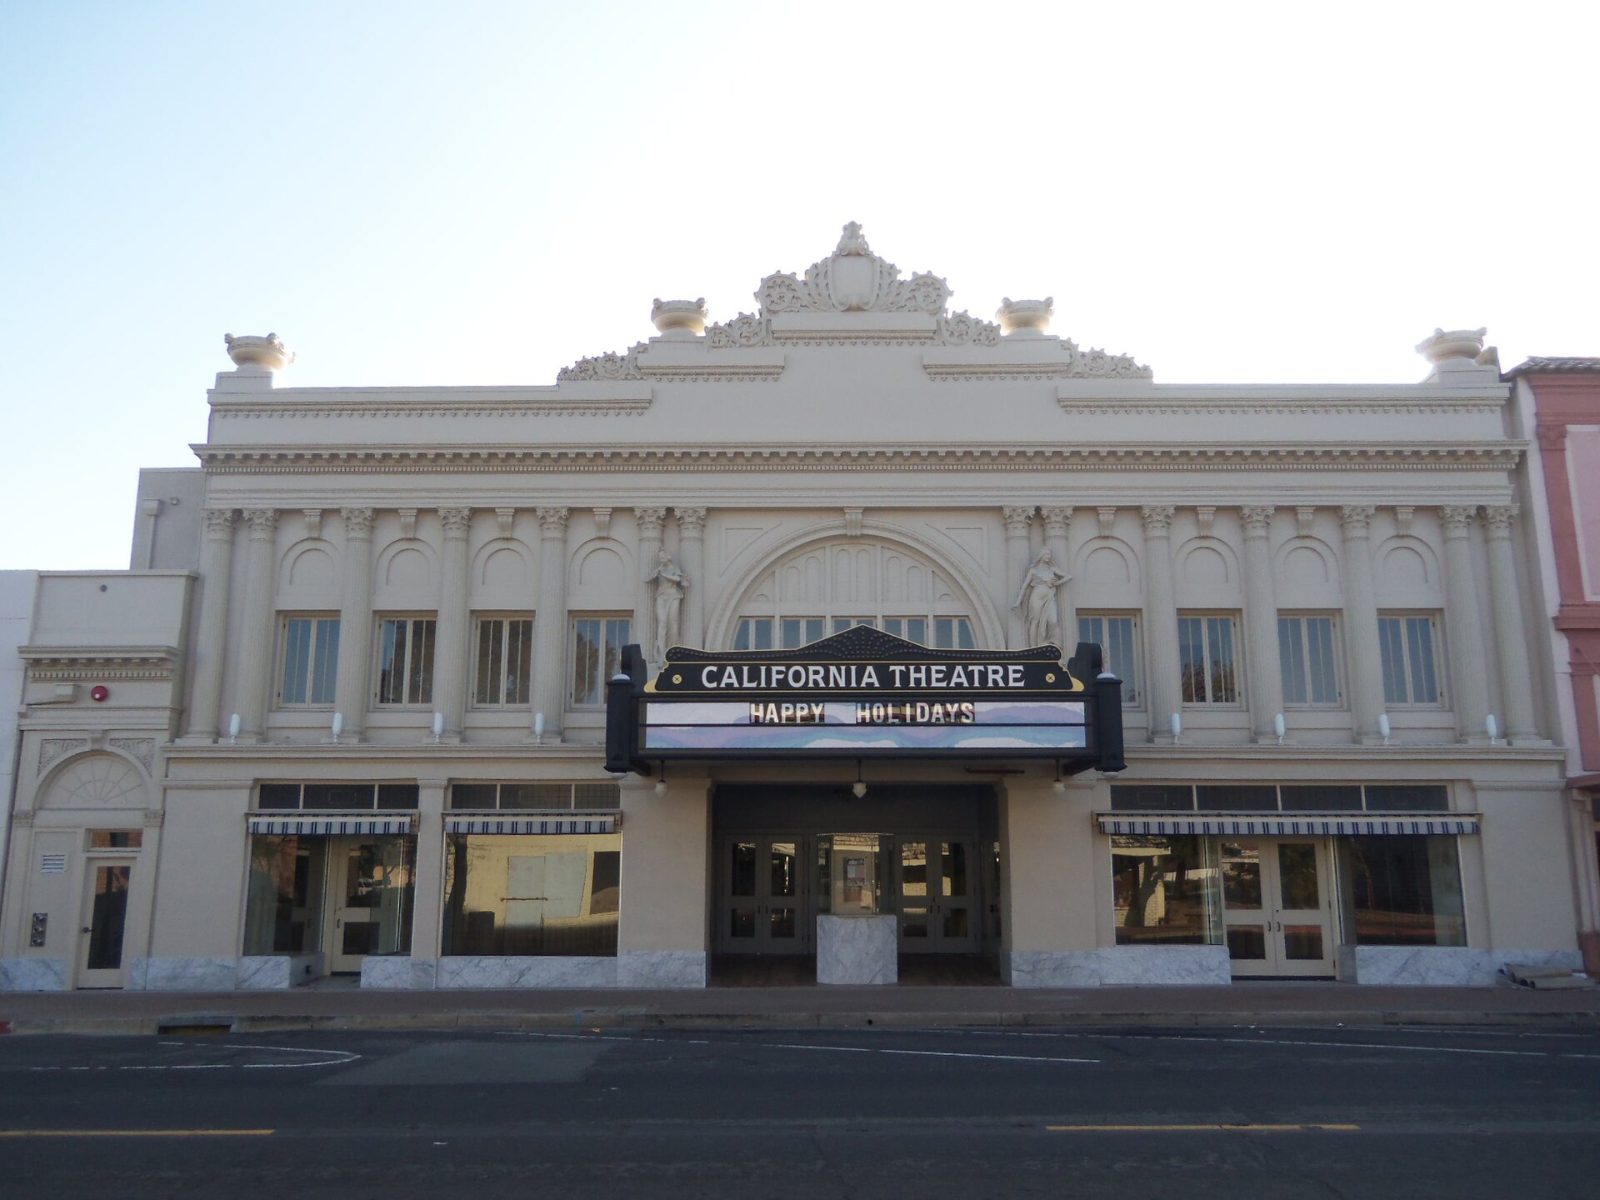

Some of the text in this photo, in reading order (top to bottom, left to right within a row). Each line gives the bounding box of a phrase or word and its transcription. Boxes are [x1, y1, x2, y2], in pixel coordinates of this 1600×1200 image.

[701, 665, 1026, 688] CALIFORNIA THEATRE
[750, 703, 974, 723] HAPPY HOLIDAYS
